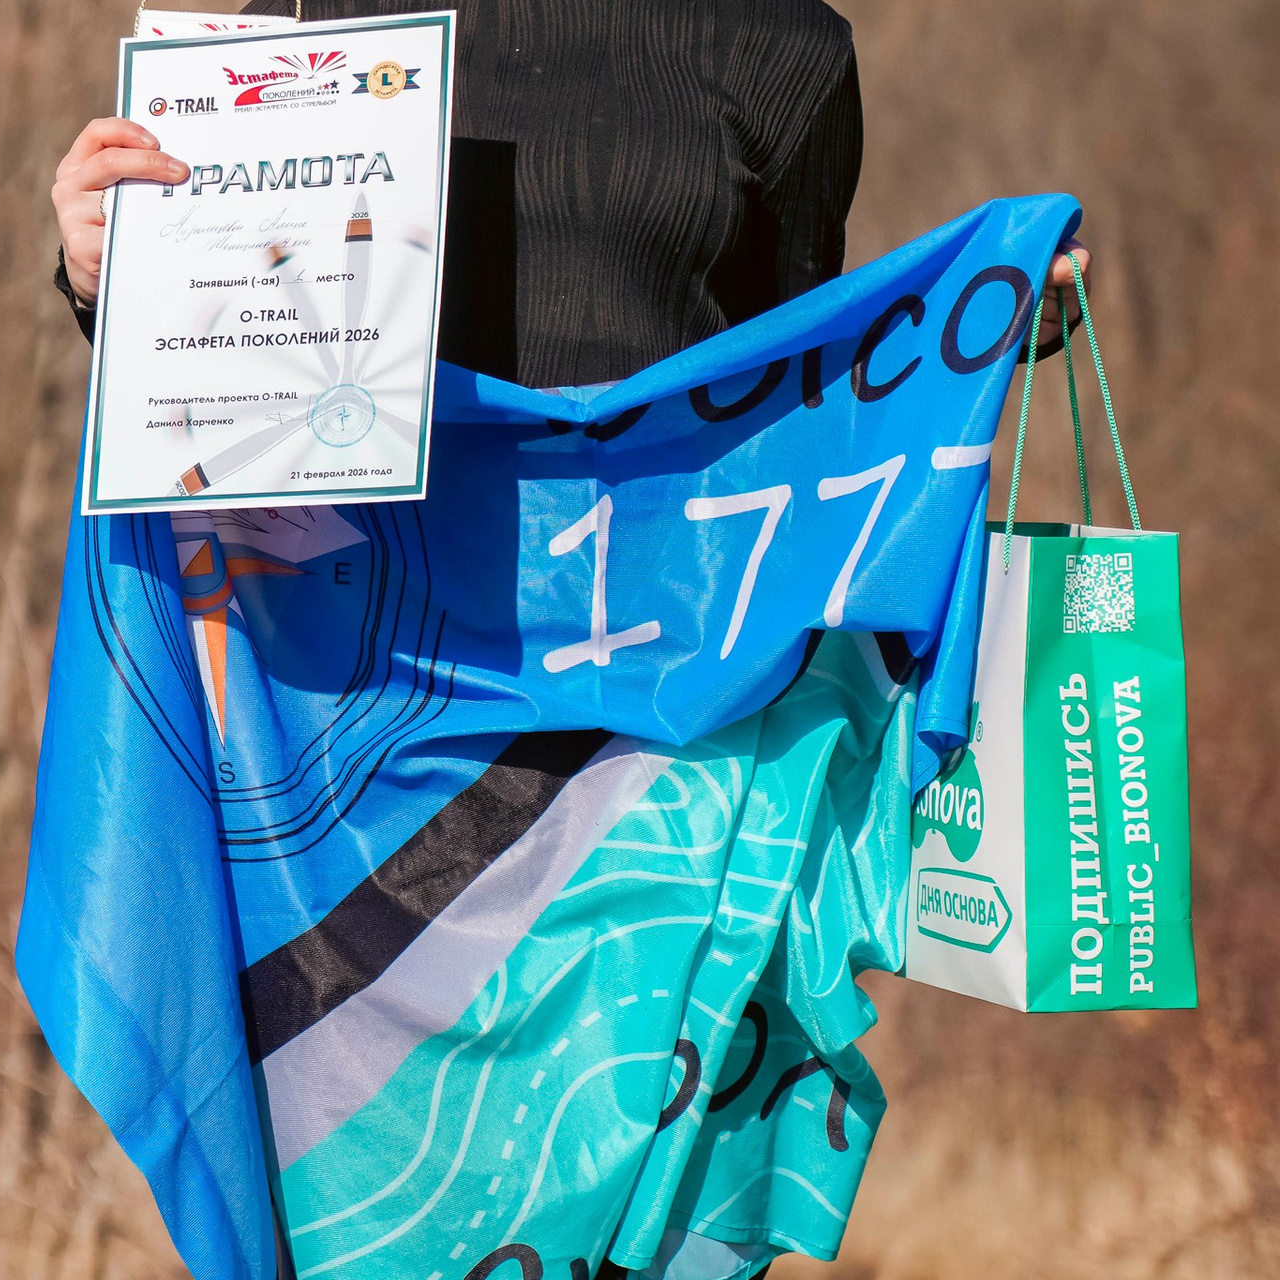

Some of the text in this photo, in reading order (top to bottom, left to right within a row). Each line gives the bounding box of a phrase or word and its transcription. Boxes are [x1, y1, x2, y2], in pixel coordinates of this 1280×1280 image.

[222, 67, 299, 86] Эстафета
[382, 73, 393, 86] L
[262, 88, 315, 100] ПОКОЛЕНИЙ
[234, 103, 288, 113] ТРЕЙЛ-ЭСТАФЕТА
[162, 151, 395, 197] РАМОТА
[351, 211, 369, 219] 2026
[189, 277, 248, 289] Занявший
[251, 275, 280, 289] (-ая)
[316, 271, 355, 283] место
[239, 308, 299, 323] O-TRAIL
[155, 328, 380, 351] ЭСТАФЕТА ПОКОЛЕНИЙ 2026
[148, 392, 298, 407] Руководитель проекта O-TRAIL
[146, 417, 234, 429] Данила Харченко
[290, 467, 393, 481] 21 февраля 2026 года
[335, 562, 352, 585] E
[220, 761, 236, 784] S
[1058, 672, 1111, 996] ПОДПИШИСЬ
[1113, 676, 1160, 994] PUBLIC_BIONOVA
[919, 882, 999, 929] ДНЯ ОСНОВА
